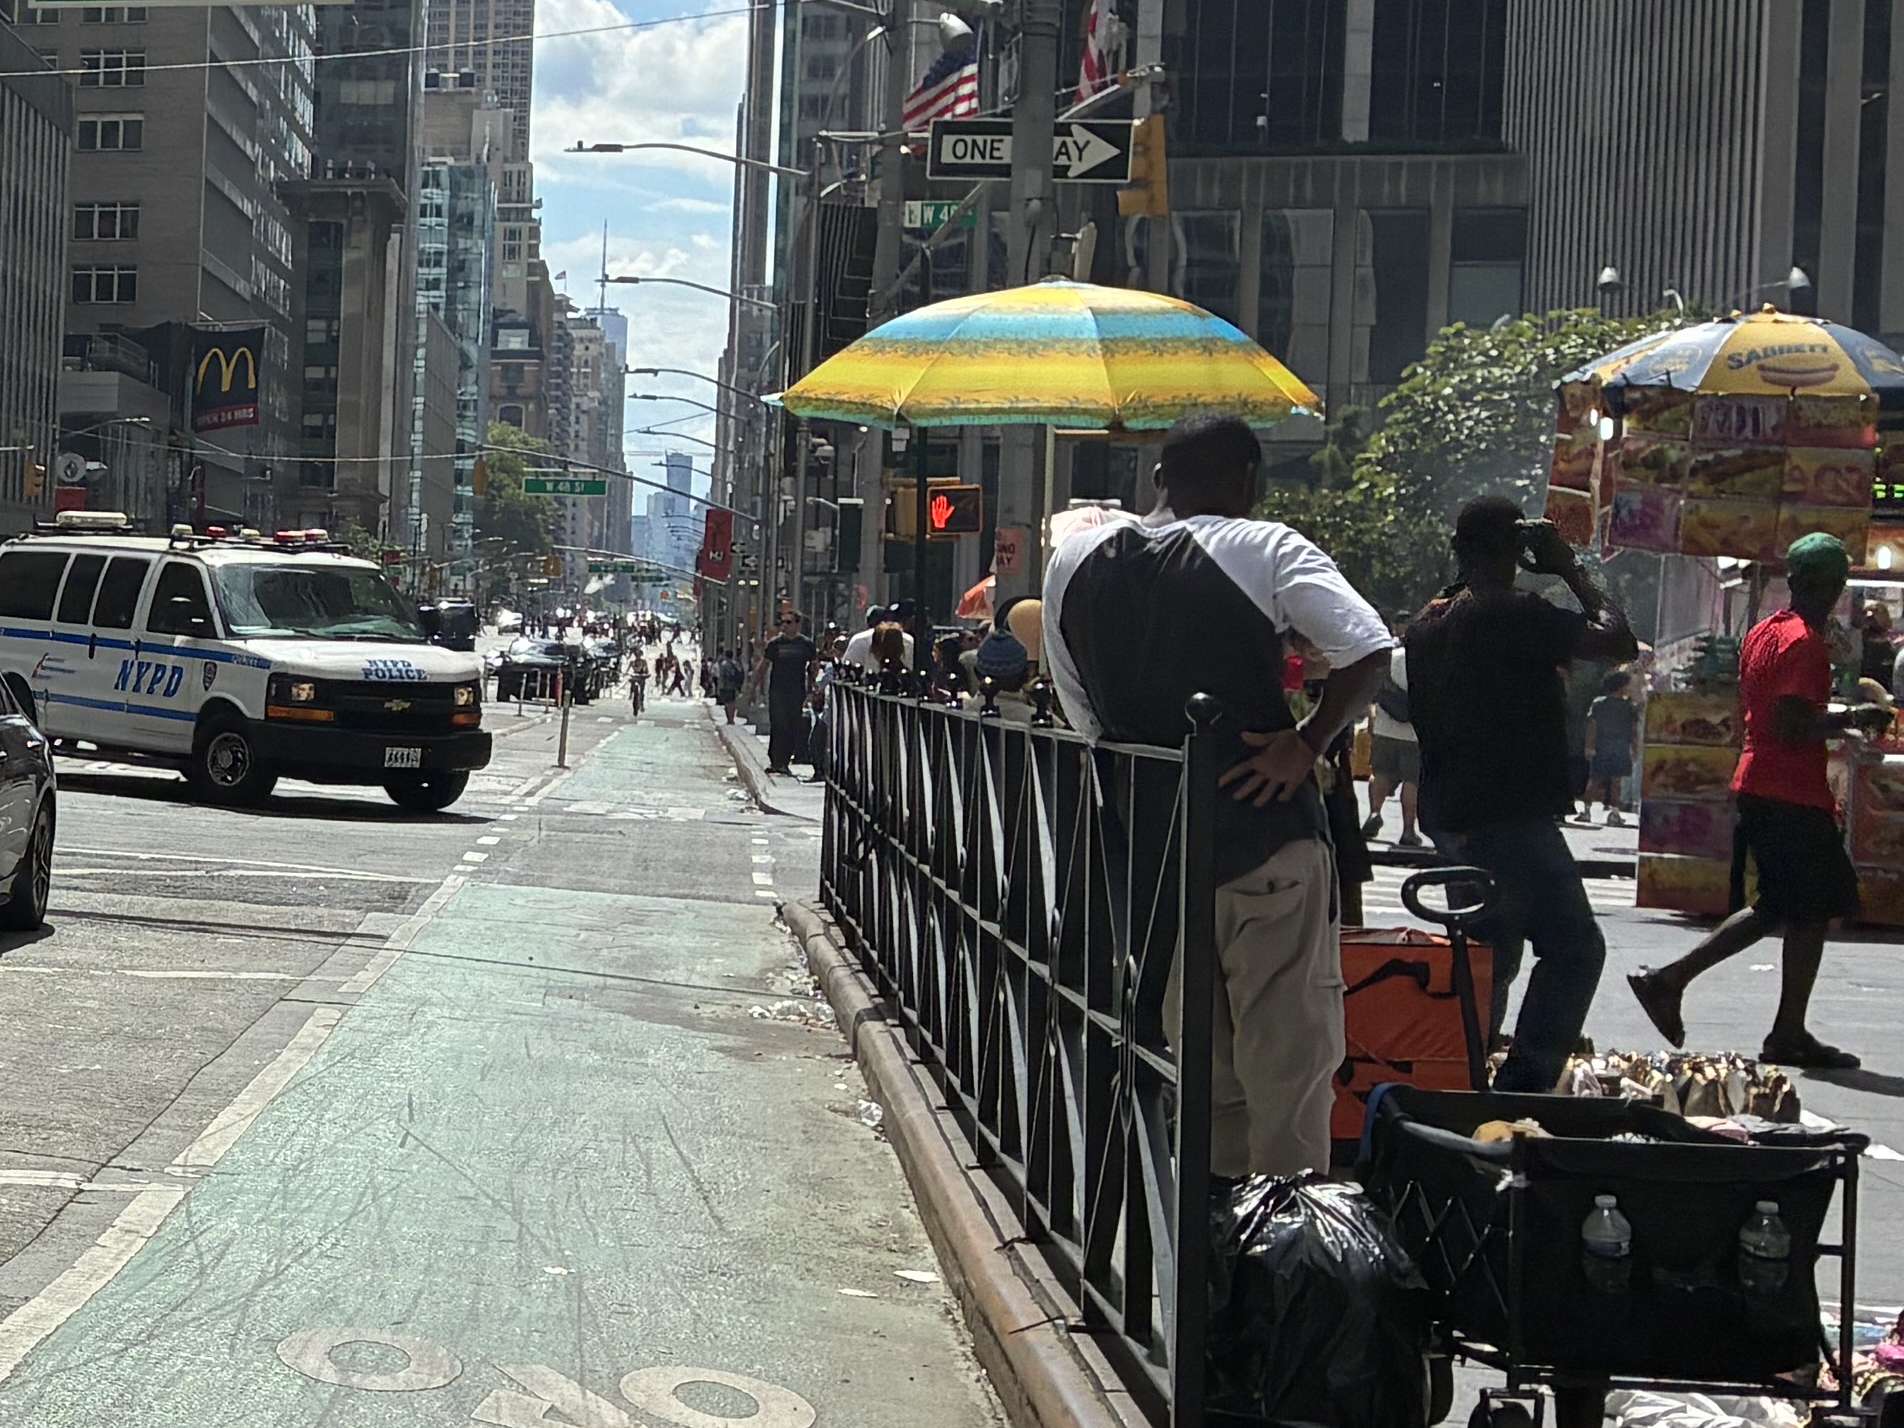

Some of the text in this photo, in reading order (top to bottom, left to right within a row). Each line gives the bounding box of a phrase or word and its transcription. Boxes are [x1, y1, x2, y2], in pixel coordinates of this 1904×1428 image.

[951, 138, 1091, 163] ONE AY
[922, 204, 935, 225] W
[361, 667, 428, 680] POLICE
[365, 658, 412, 668] NYPD
[113, 658, 184, 698] NYPD
